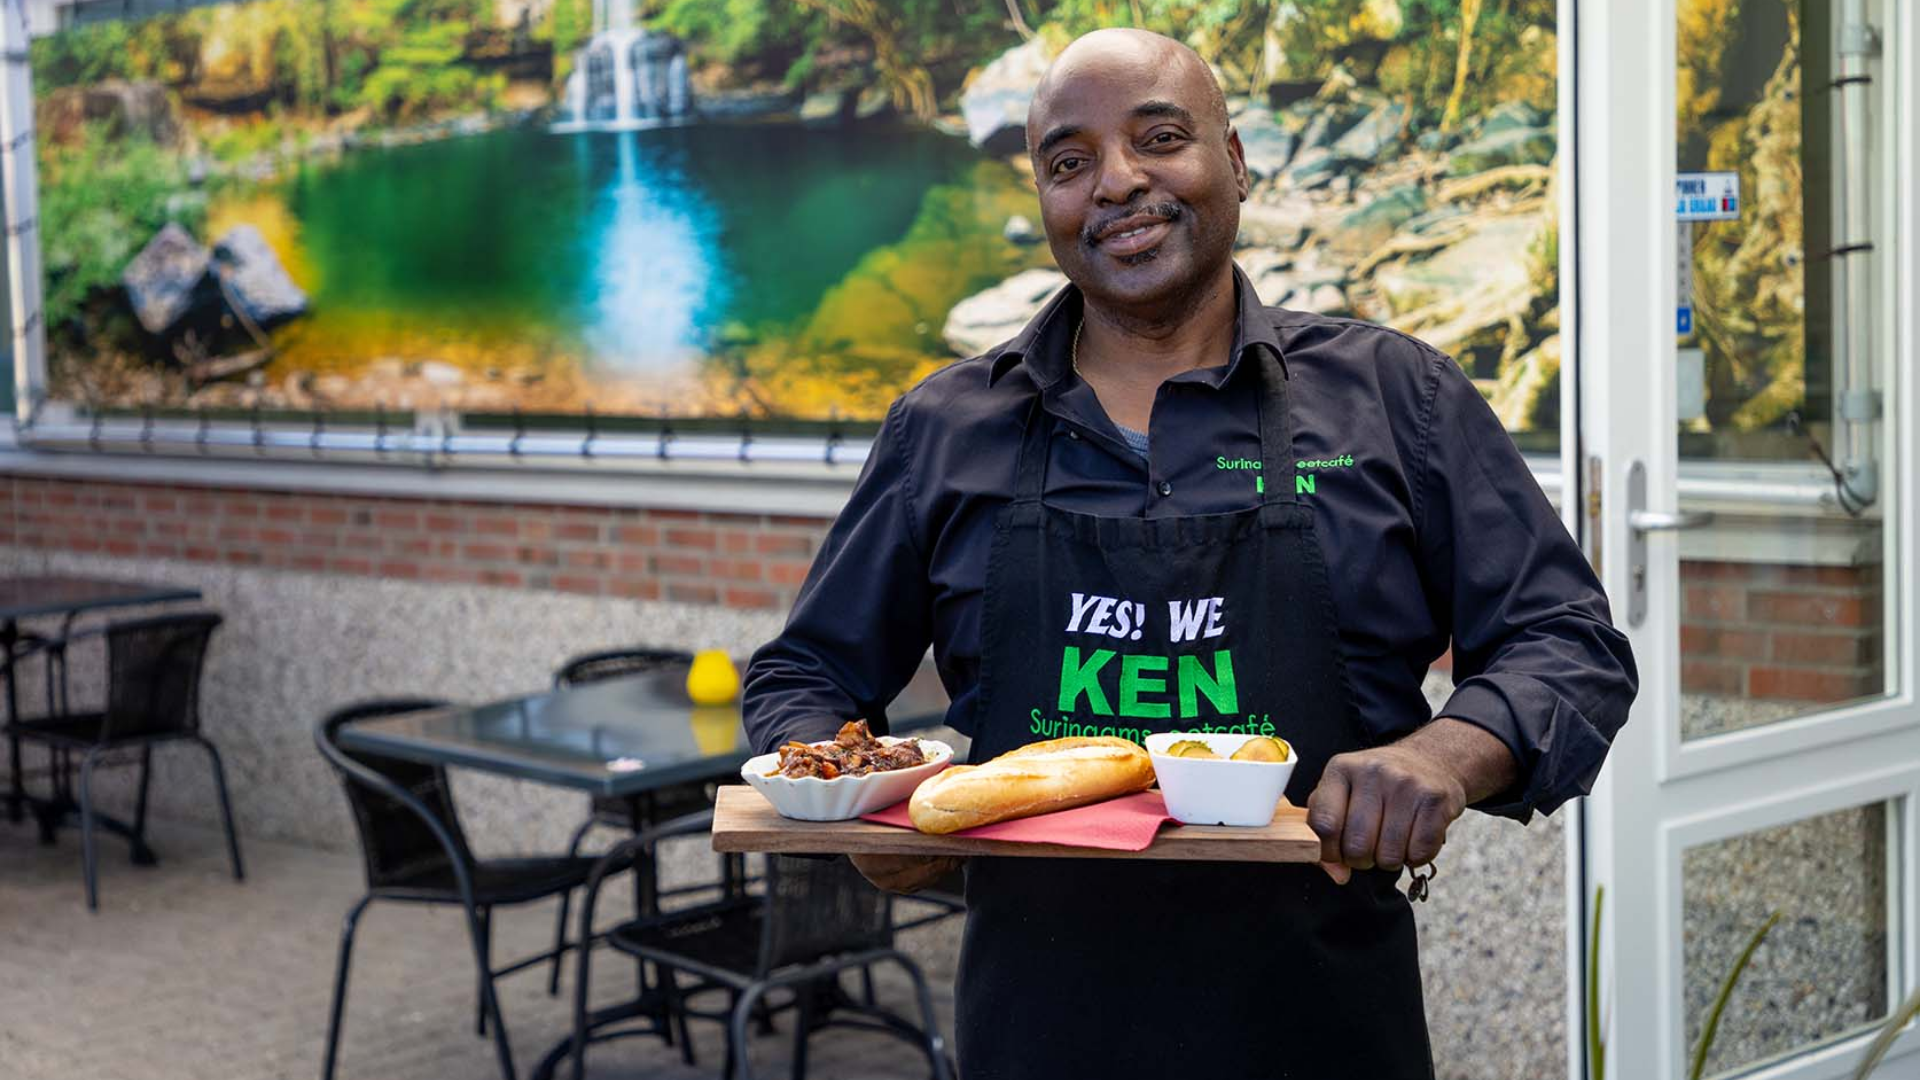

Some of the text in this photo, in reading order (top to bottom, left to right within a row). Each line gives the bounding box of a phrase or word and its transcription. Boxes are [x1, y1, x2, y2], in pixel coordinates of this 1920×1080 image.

[1216, 456, 1263, 470] Surina
[1065, 592, 1226, 643] YES! WE
[1058, 646, 1239, 719] KEN
[1169, 714, 1276, 736] tcafé
